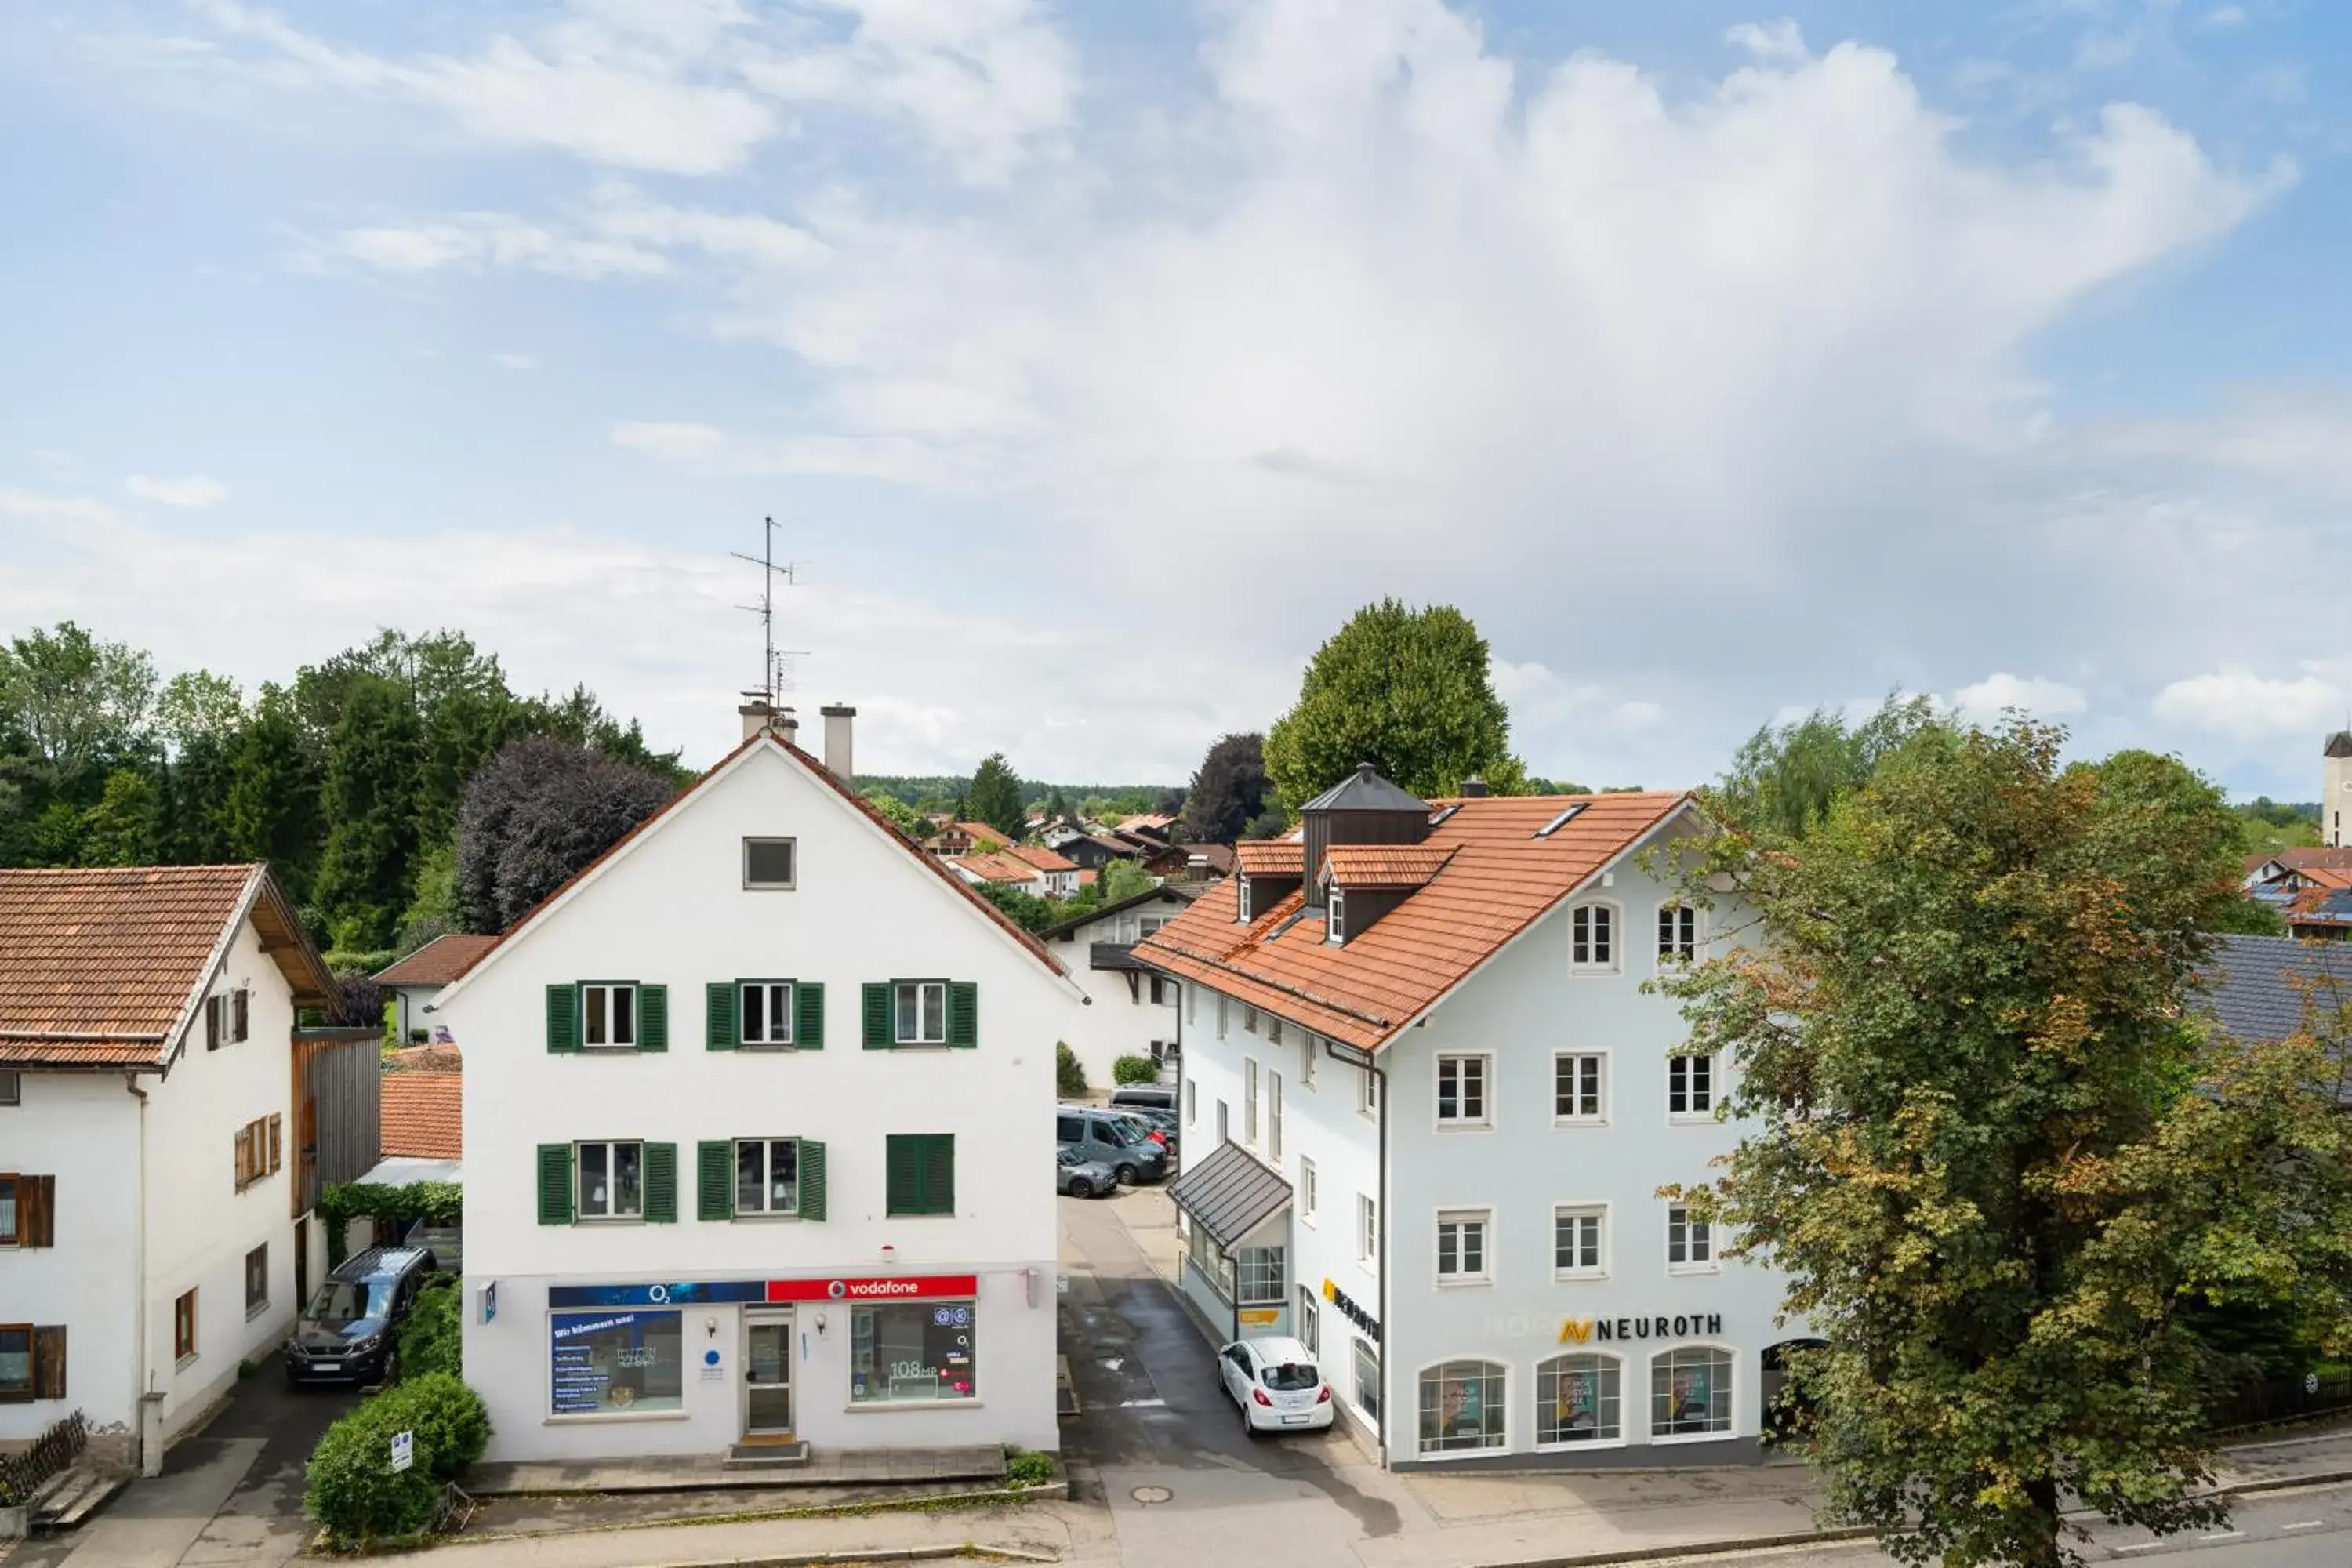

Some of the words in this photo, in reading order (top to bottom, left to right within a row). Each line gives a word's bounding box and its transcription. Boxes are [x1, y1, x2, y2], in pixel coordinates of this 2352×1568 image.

[850, 1279, 919, 1295] vodafone
[554, 1328, 570, 1338] Wir
[1596, 1313, 1722, 1341] NEUROTH
